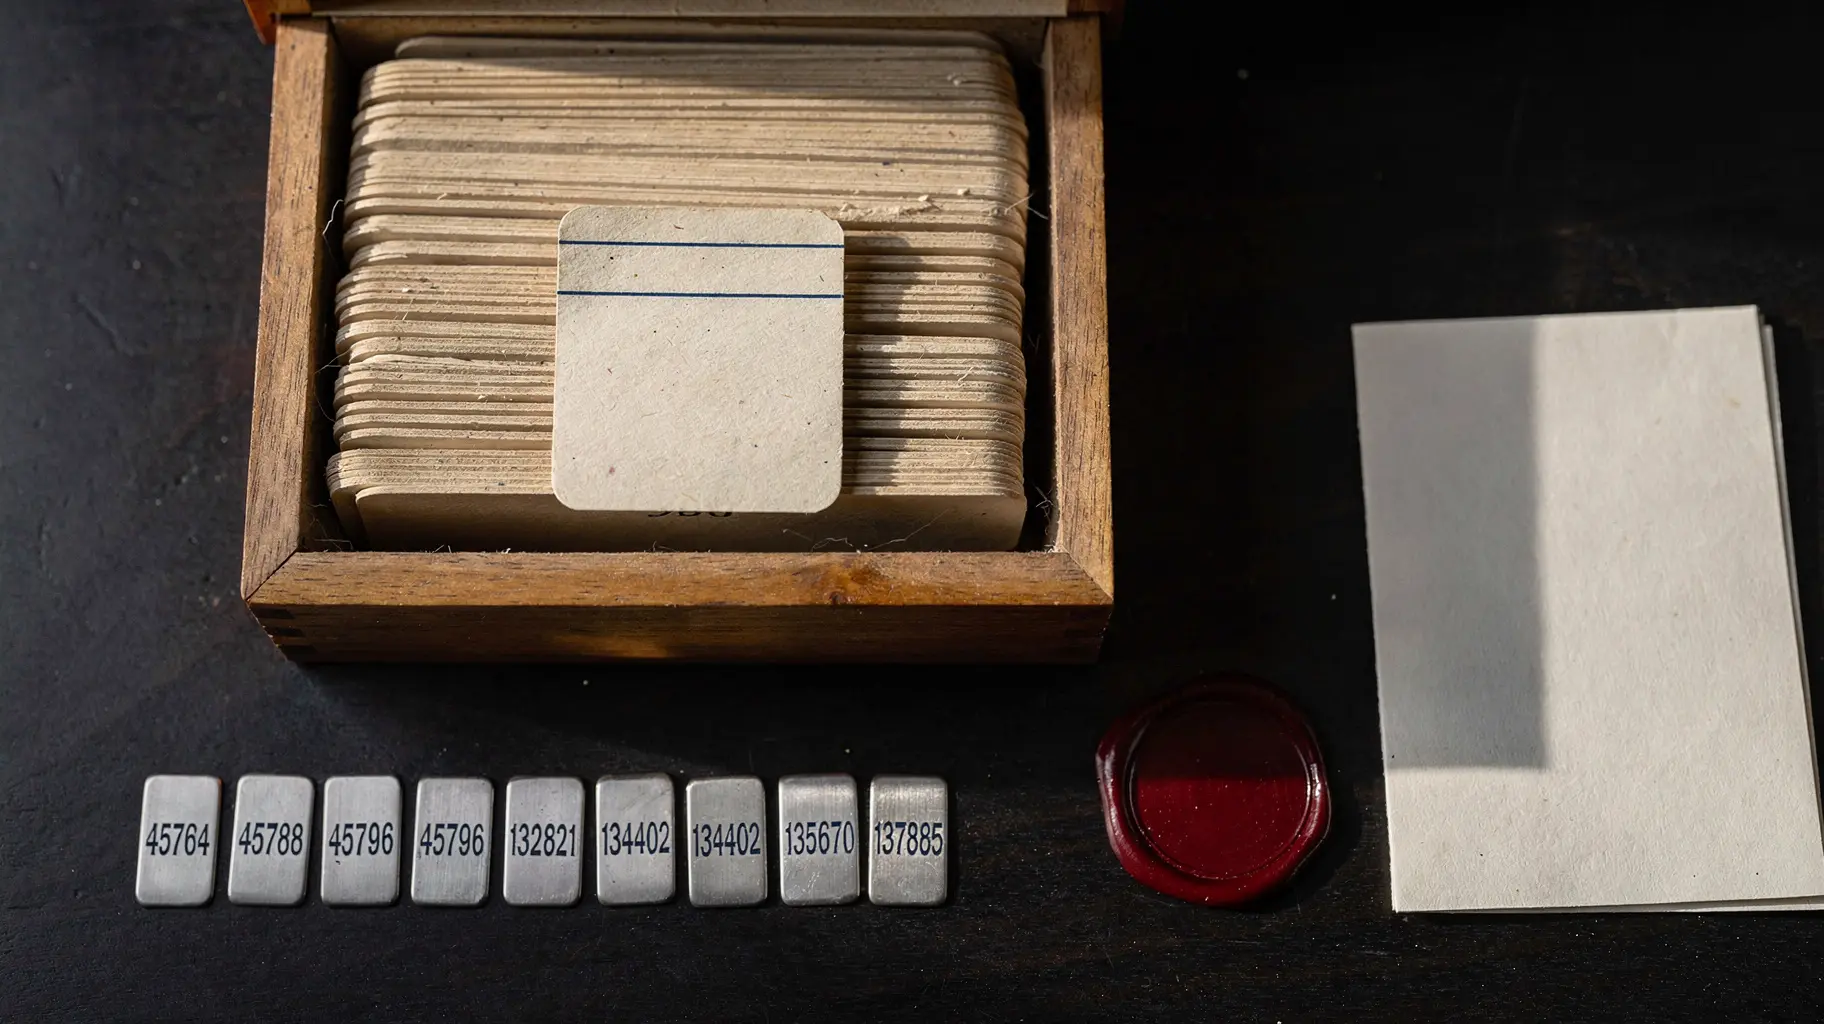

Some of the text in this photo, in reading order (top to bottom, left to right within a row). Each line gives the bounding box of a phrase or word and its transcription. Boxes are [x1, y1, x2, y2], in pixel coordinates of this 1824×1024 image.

[146, 823, 210, 856] 45764
[238, 822, 303, 856] 45788
[328, 822, 394, 856] 45796
[420, 823, 484, 856] 45796
[510, 823, 576, 857] 132821
[601, 821, 670, 855] 134402
[692, 822, 761, 857] 134402
[785, 821, 855, 855] 135670
[874, 821, 943, 856] 137885
